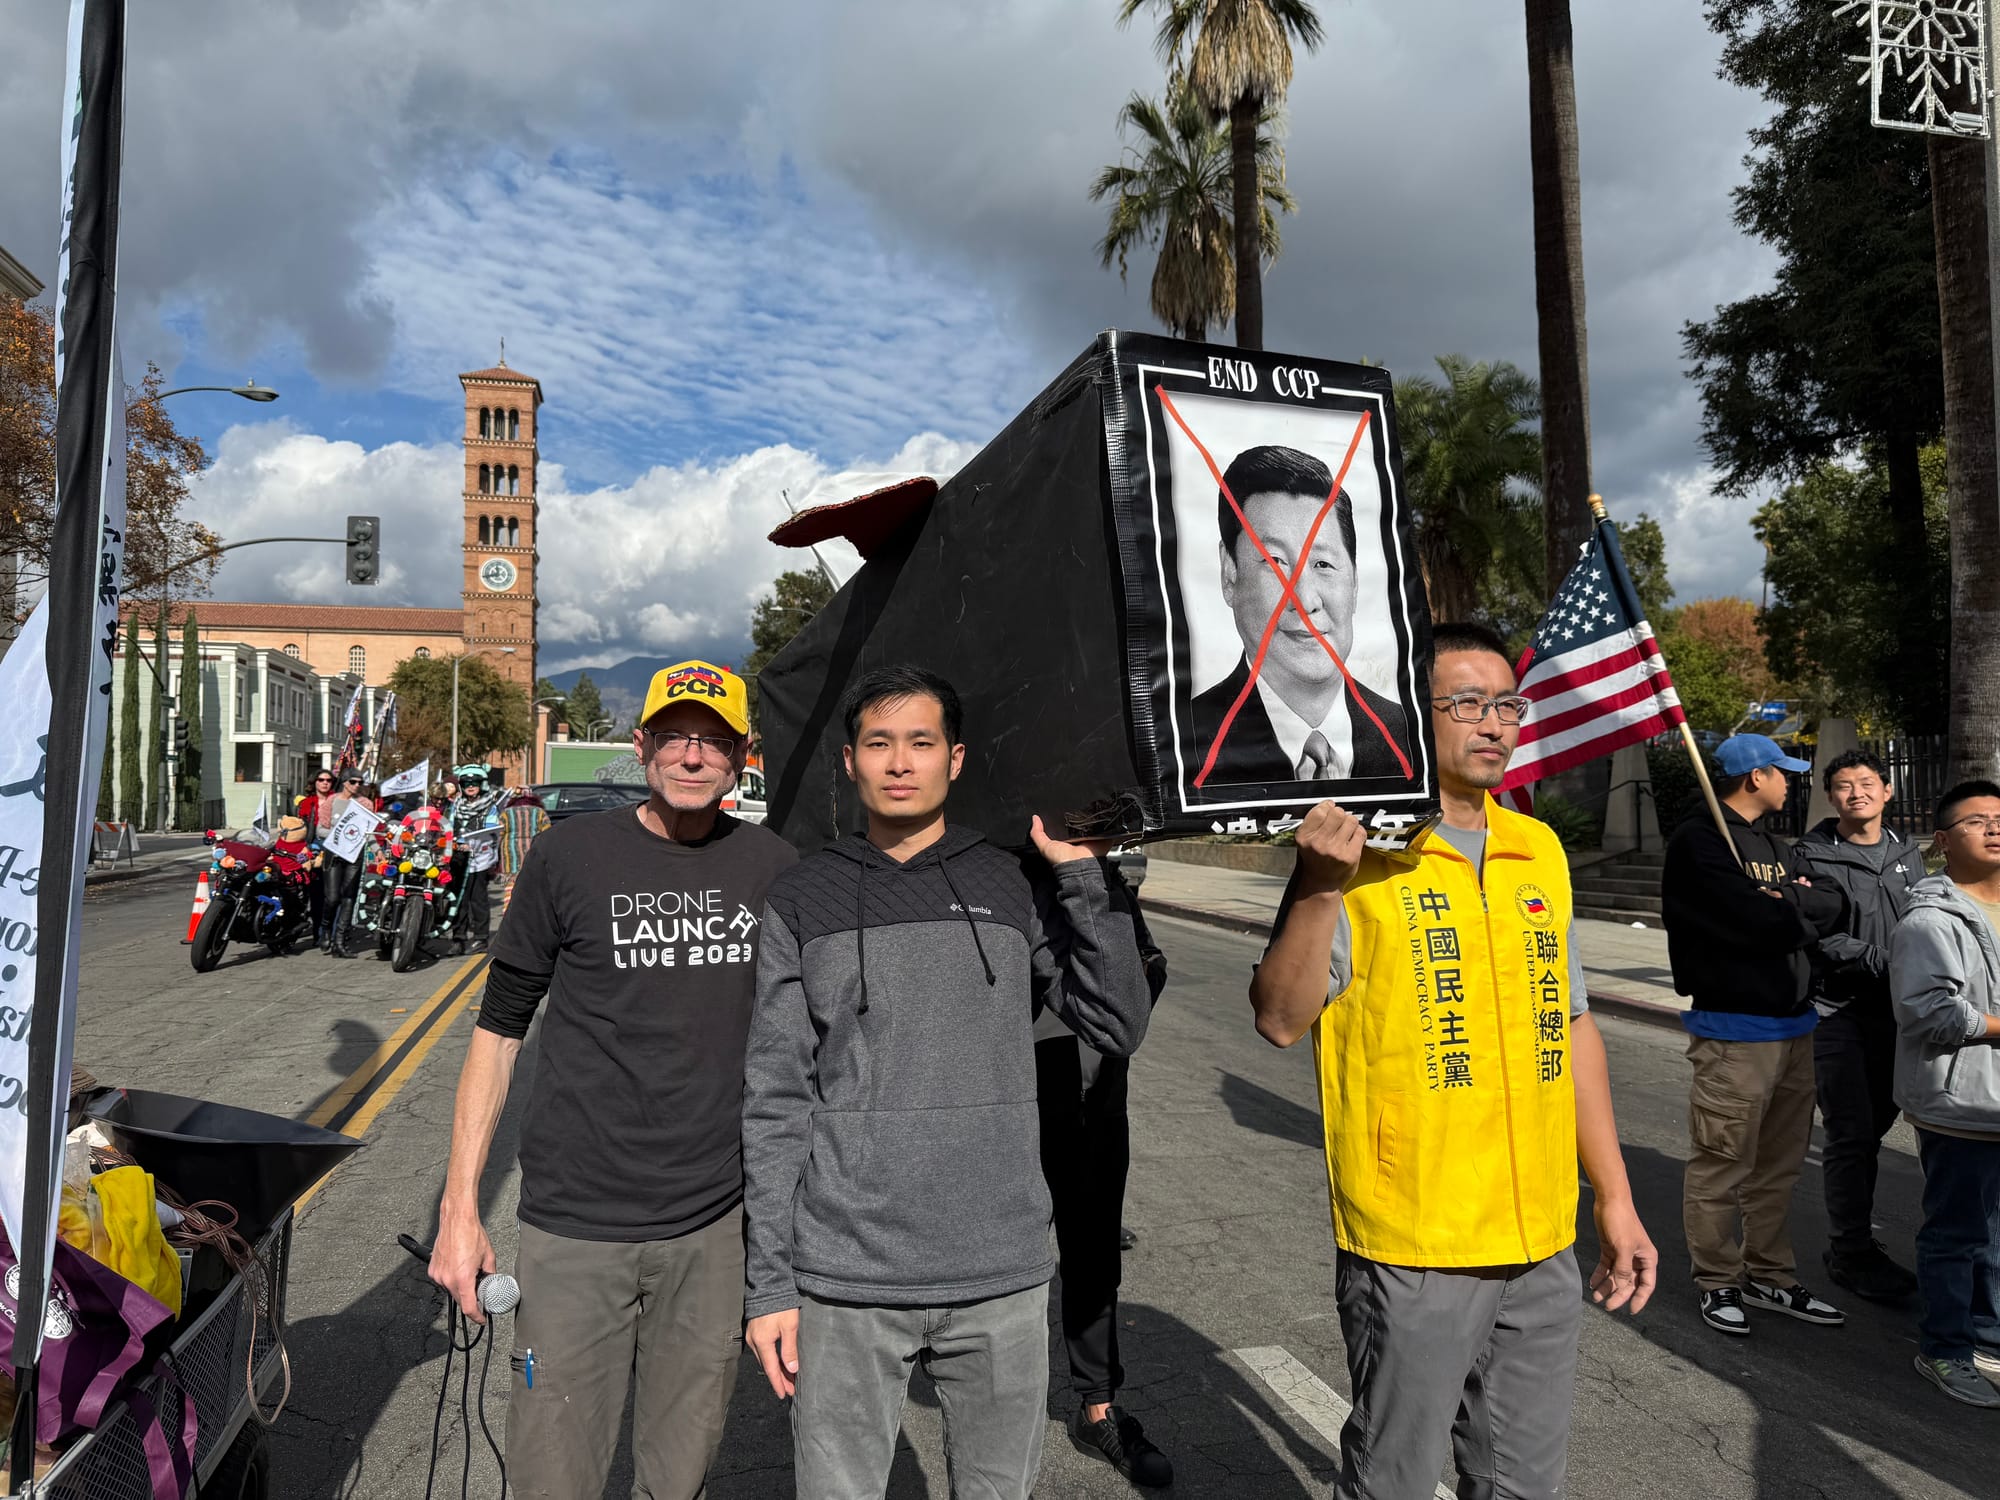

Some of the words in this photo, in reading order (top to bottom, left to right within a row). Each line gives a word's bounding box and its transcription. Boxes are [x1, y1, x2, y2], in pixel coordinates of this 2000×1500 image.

[1207, 356, 1258, 393] END
[1272, 366, 1320, 400] CCP
[666, 666, 724, 687] END
[667, 679, 727, 698] CCP
[611, 889, 724, 918] DRONE
[612, 904, 758, 946] LAUNCH
[957, 903, 992, 915] Clumbia
[1400, 885, 1419, 932] CHINA
[614, 947, 675, 969] LIVE
[688, 943, 753, 966] 2023
[1522, 930, 1536, 978] UNITED
[1409, 938, 1435, 1036] DEMOCRACY
[1418, 887, 1473, 1089] 中國民主黨
[1533, 930, 1565, 1083] 聯合總部
[1424, 1042, 1440, 1093] PARTY
